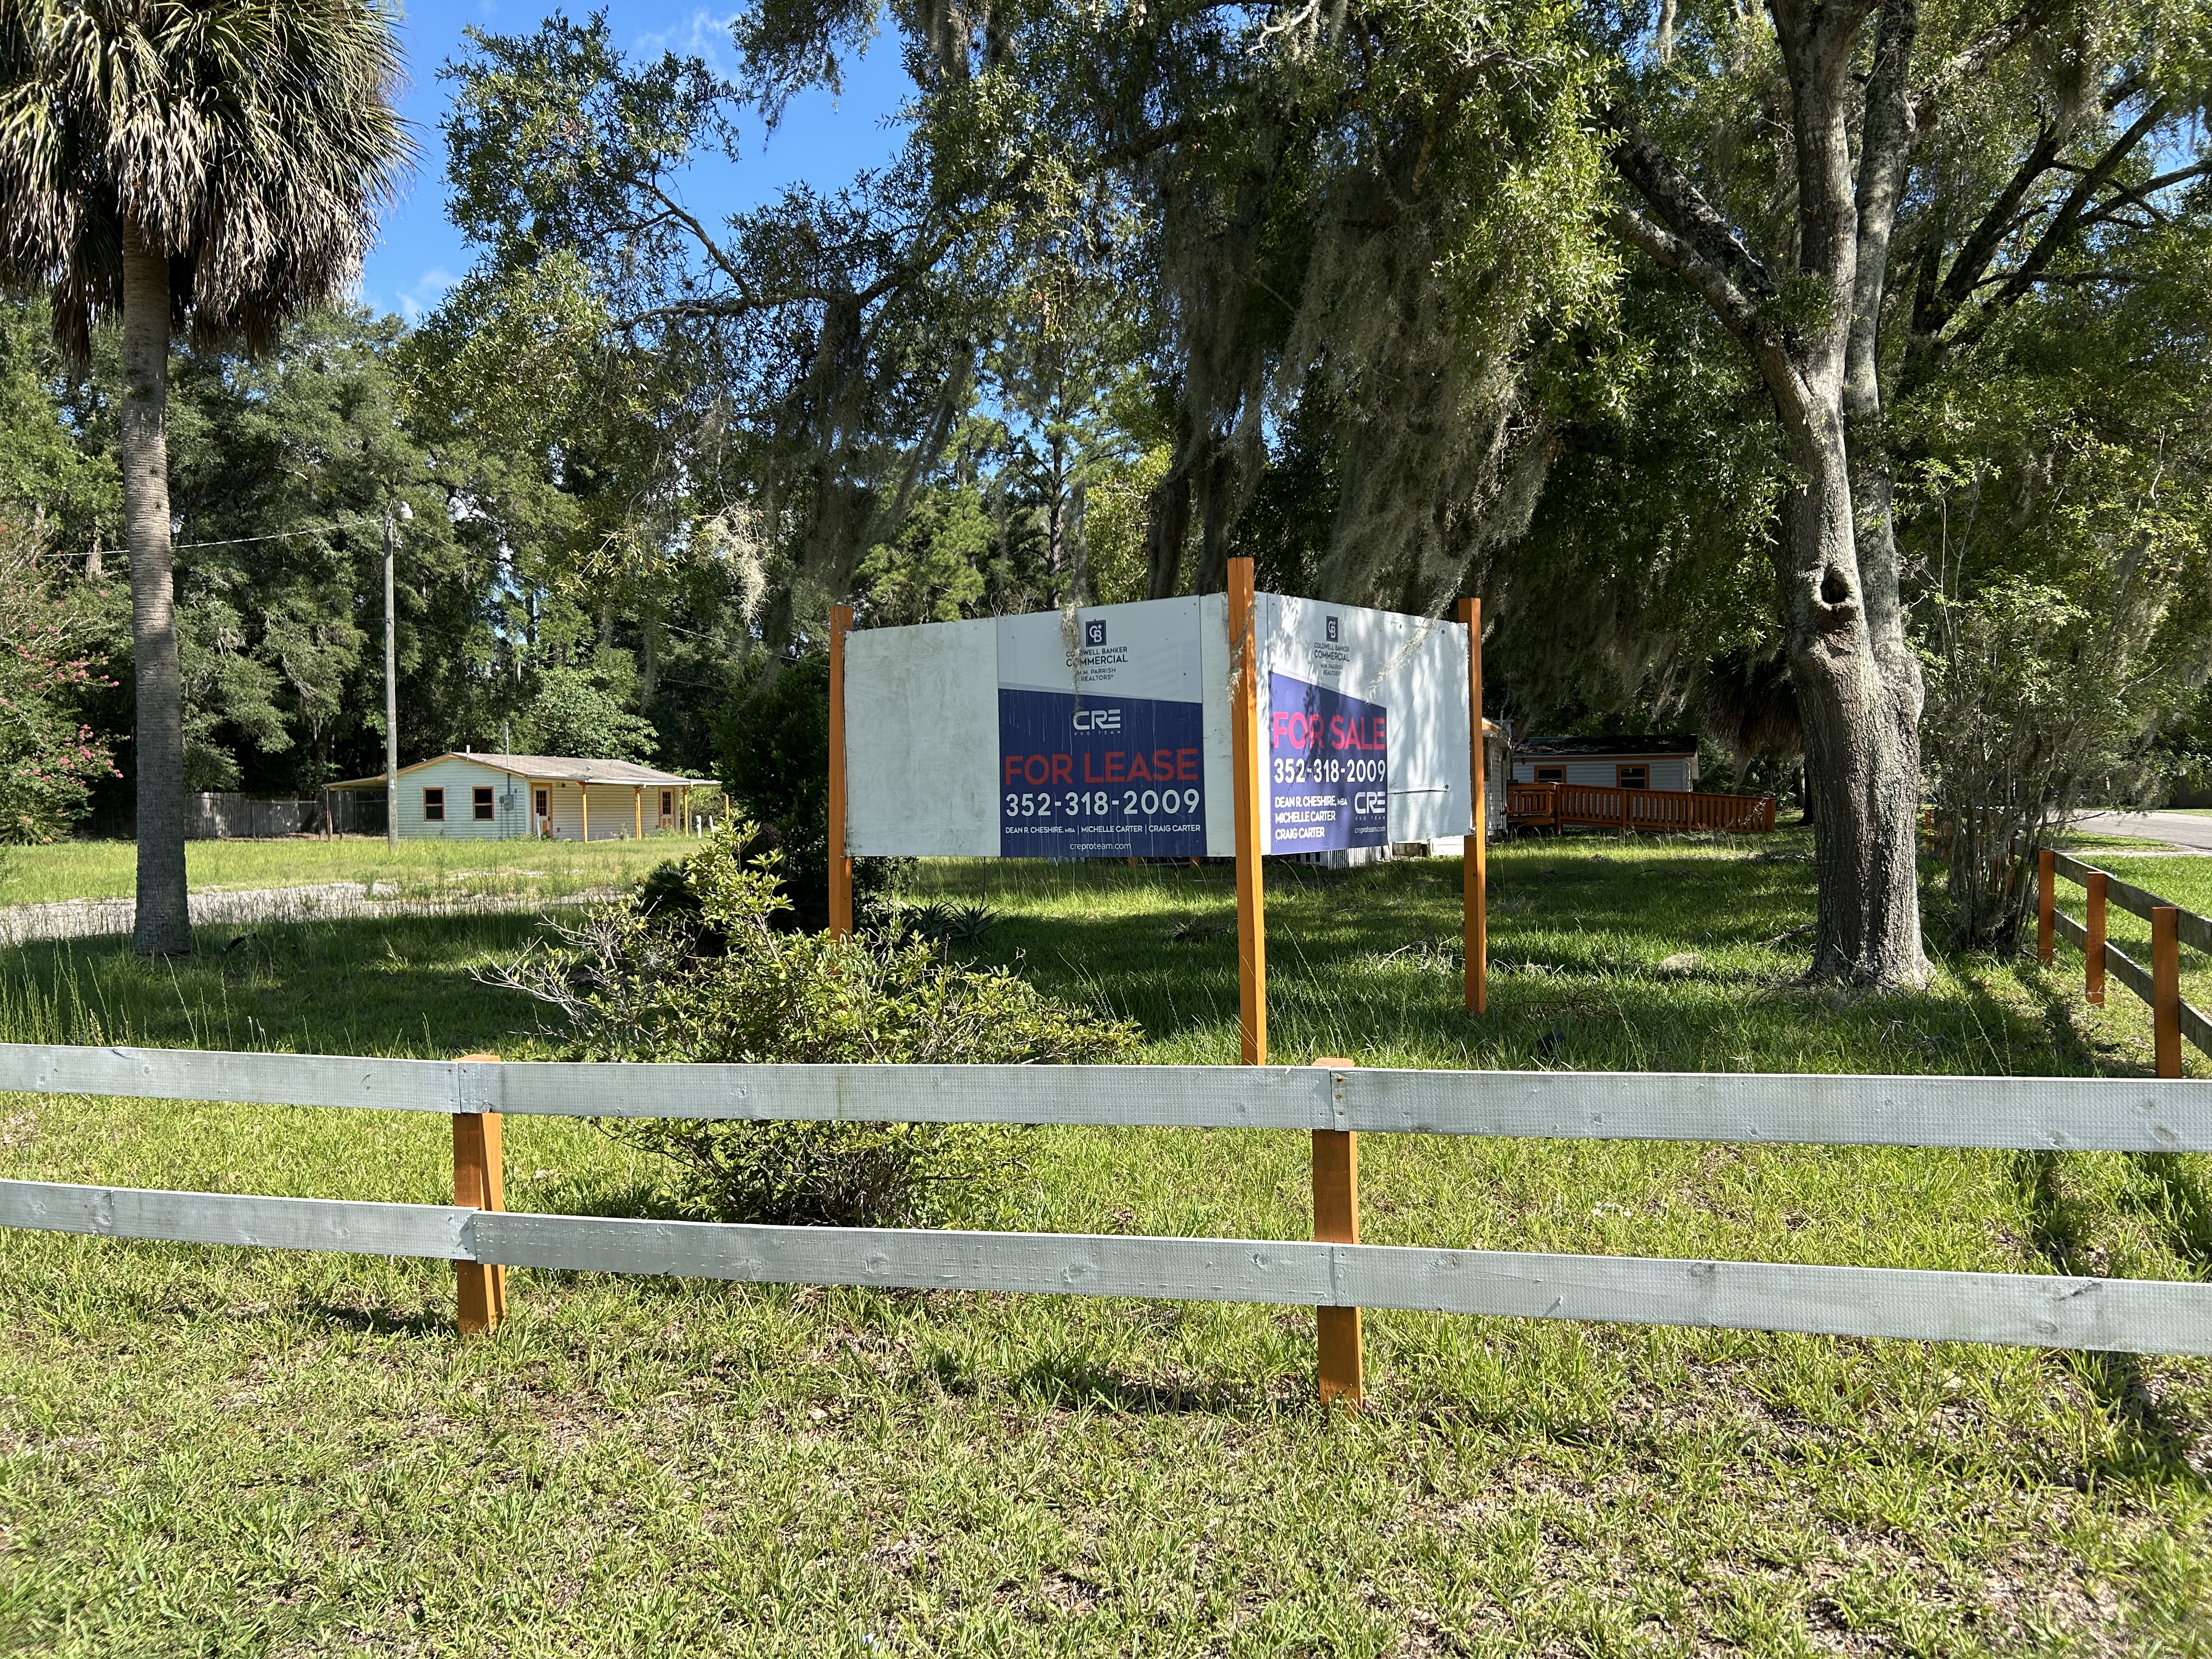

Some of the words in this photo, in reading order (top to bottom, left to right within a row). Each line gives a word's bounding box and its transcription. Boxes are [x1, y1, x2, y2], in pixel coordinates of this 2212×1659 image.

[1102, 646, 1127, 655] BANKER
[1314, 642, 1334, 651] COLDWELL
[1066, 654, 1128, 667] CMMERCIAL
[1314, 650, 1350, 662] COMMERCIAL
[1073, 709, 1121, 730] CRE
[1273, 711, 1325, 749] FOR
[1330, 715, 1386, 750] SALE
[1005, 754, 1073, 786] FOR
[1084, 748, 1198, 783] LEASE
[1274, 758, 1386, 783] 352-318-2009
[1006, 788, 1199, 817] 352-318-2009
[1274, 796, 1295, 808] DEAN
[1295, 796, 1302, 808] R.
[1302, 795, 1336, 807] CHESHIRE,
[1354, 791, 1386, 814] CRE
[1275, 811, 1310, 823] MICHELLE
[1310, 810, 1336, 822] CARTER
[1172, 824, 1201, 832] CARTER
[1275, 828, 1297, 840] CRAIG
[1298, 827, 1325, 838] CARTER
[1070, 842, 1131, 851] creproteam.com
